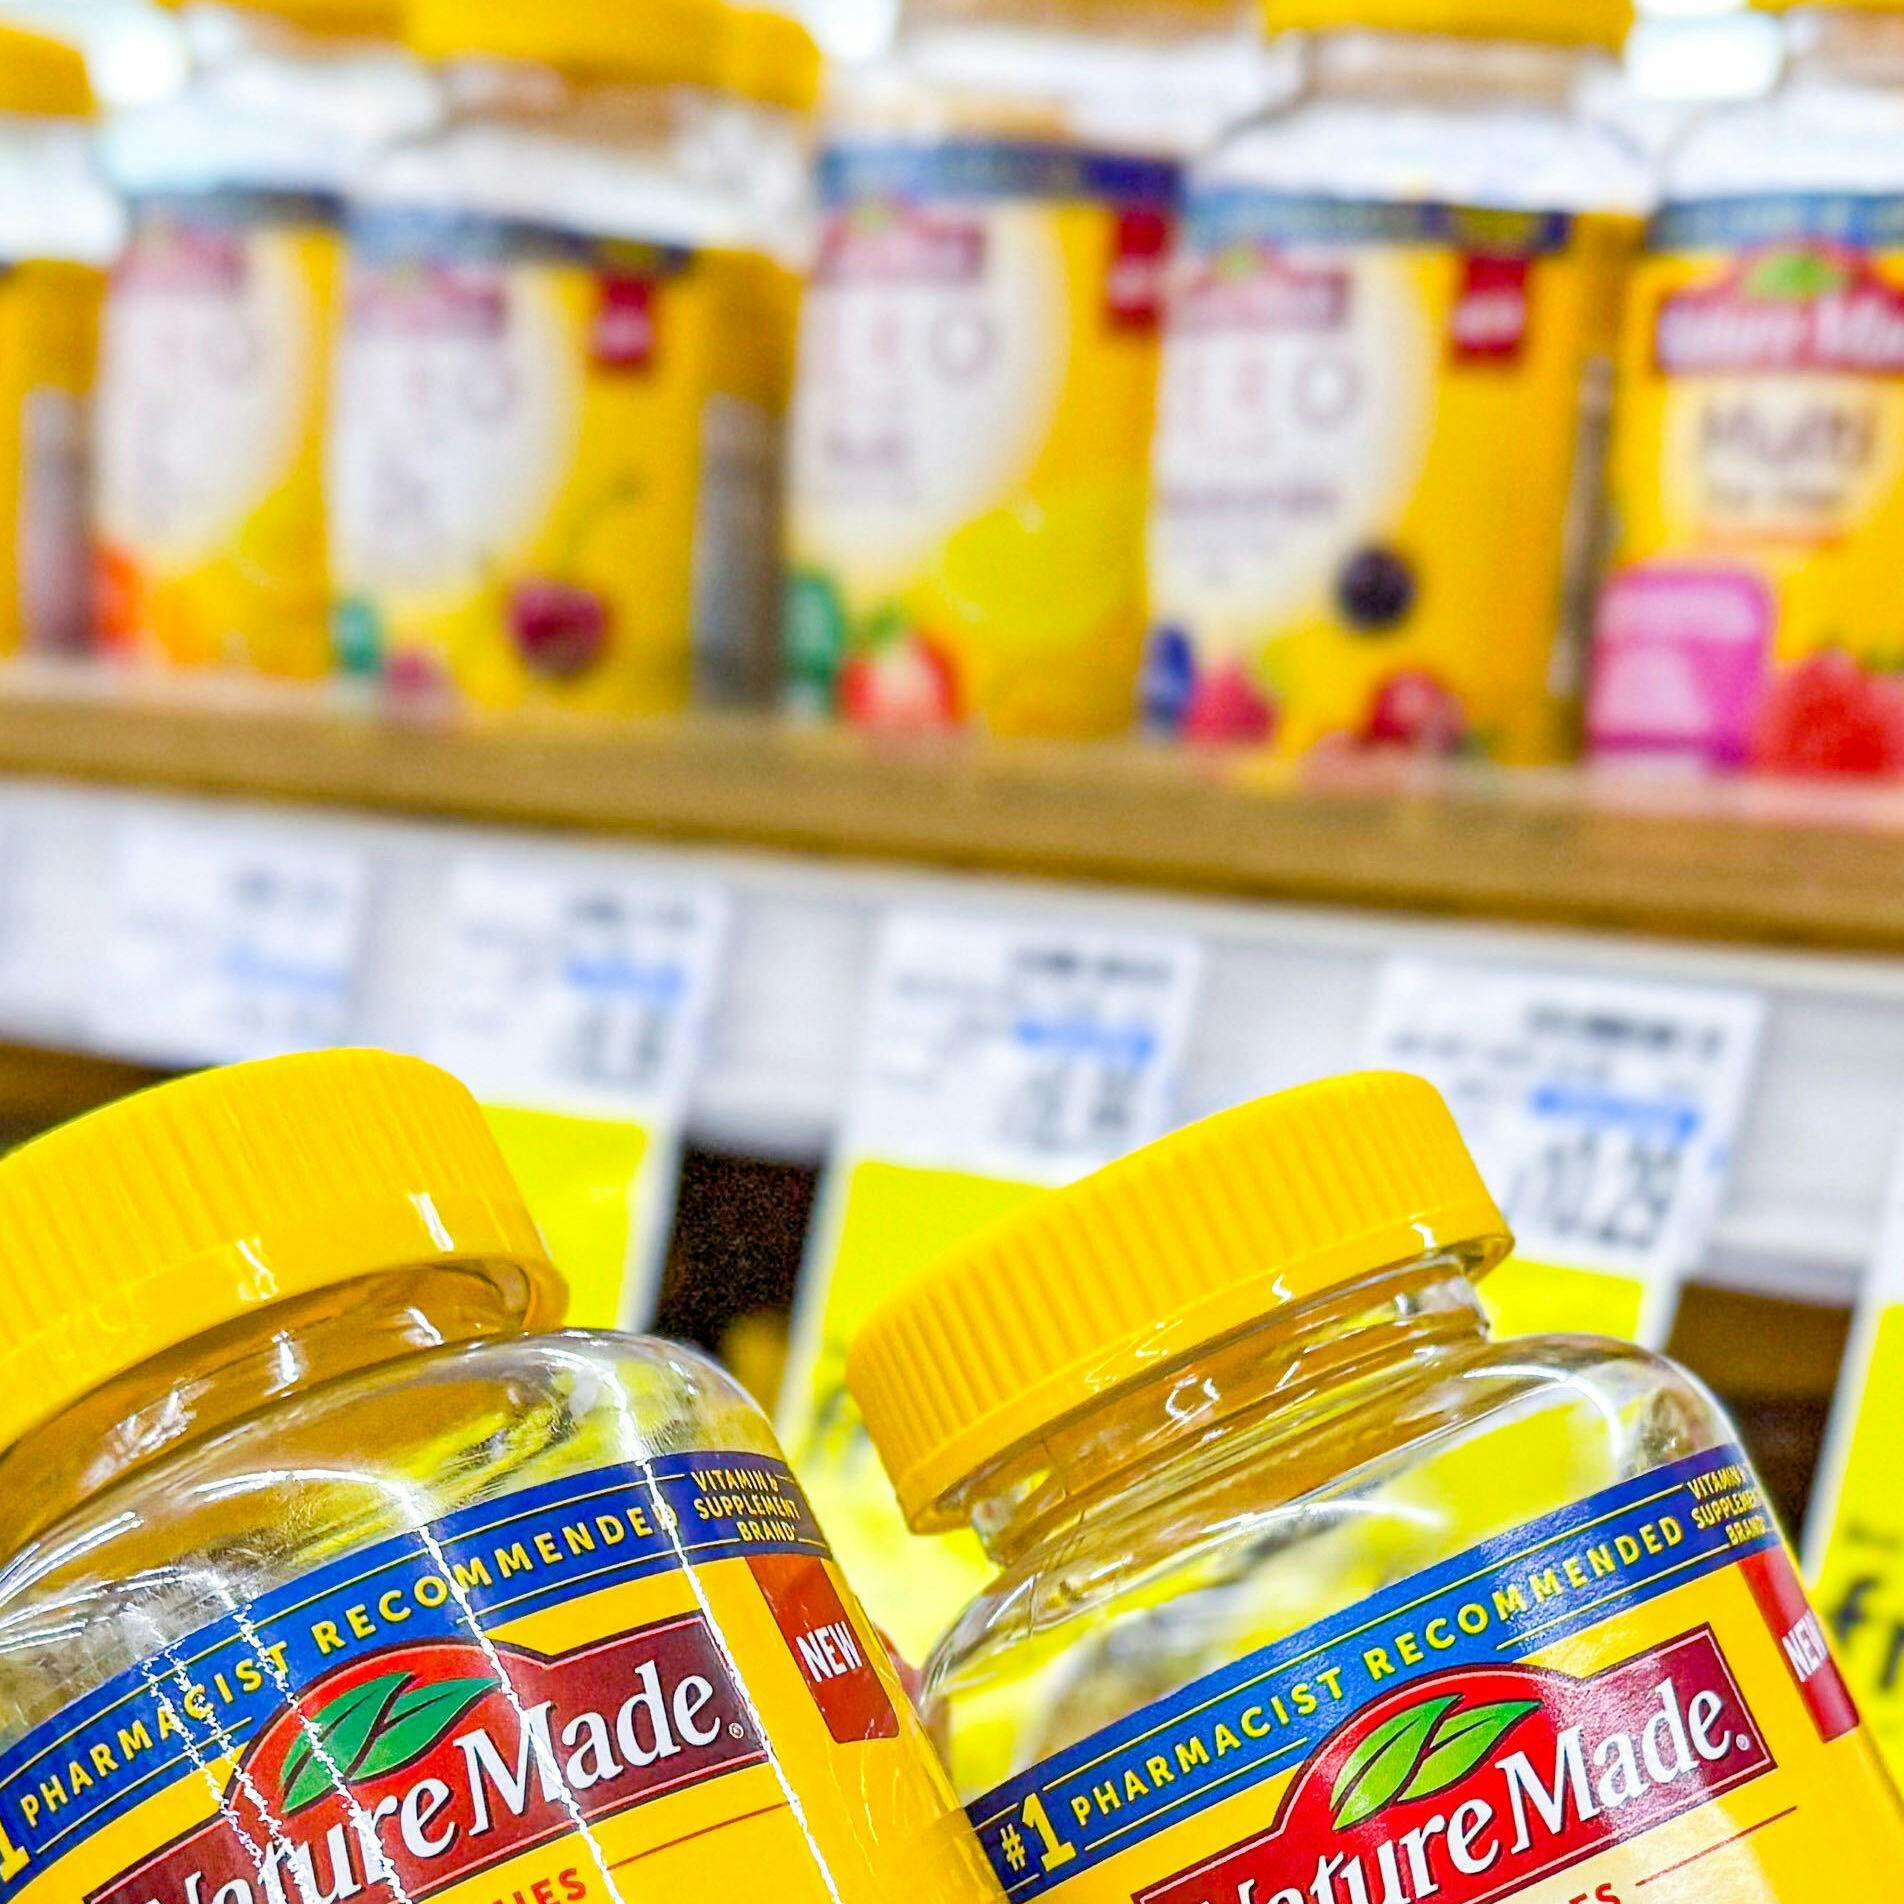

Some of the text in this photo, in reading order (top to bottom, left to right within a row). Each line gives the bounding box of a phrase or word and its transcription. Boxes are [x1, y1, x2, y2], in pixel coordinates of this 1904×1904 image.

[690, 1468, 769, 1492] VITAMIN
[693, 1494, 801, 1520] SUPPLEMENT
[20, 1641, 289, 1828] PHARMACIST
[309, 1503, 679, 1657] RECOMMENDED
[795, 1620, 864, 1684] NEW
[1000, 1515, 1684, 1873] #1 PHARMACIST RECOMMENDED
